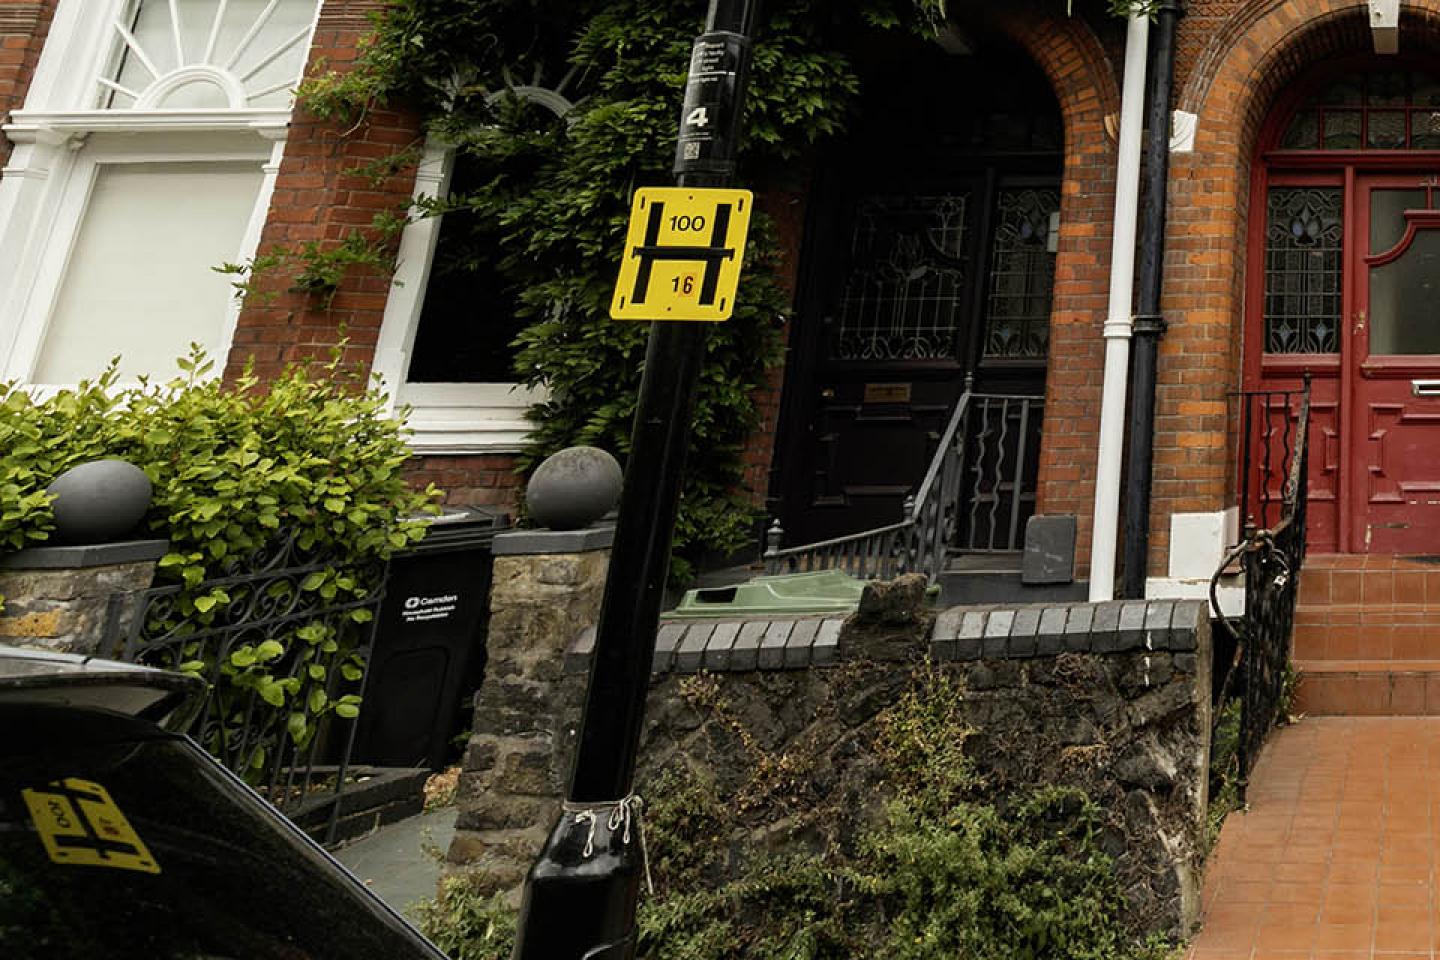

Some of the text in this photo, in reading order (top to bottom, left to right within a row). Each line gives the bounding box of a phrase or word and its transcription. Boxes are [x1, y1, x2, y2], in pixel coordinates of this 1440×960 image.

[686, 107, 708, 127] 4
[669, 215, 705, 232] 100
[671, 276, 694, 295] 16
[420, 595, 458, 606] Camden
